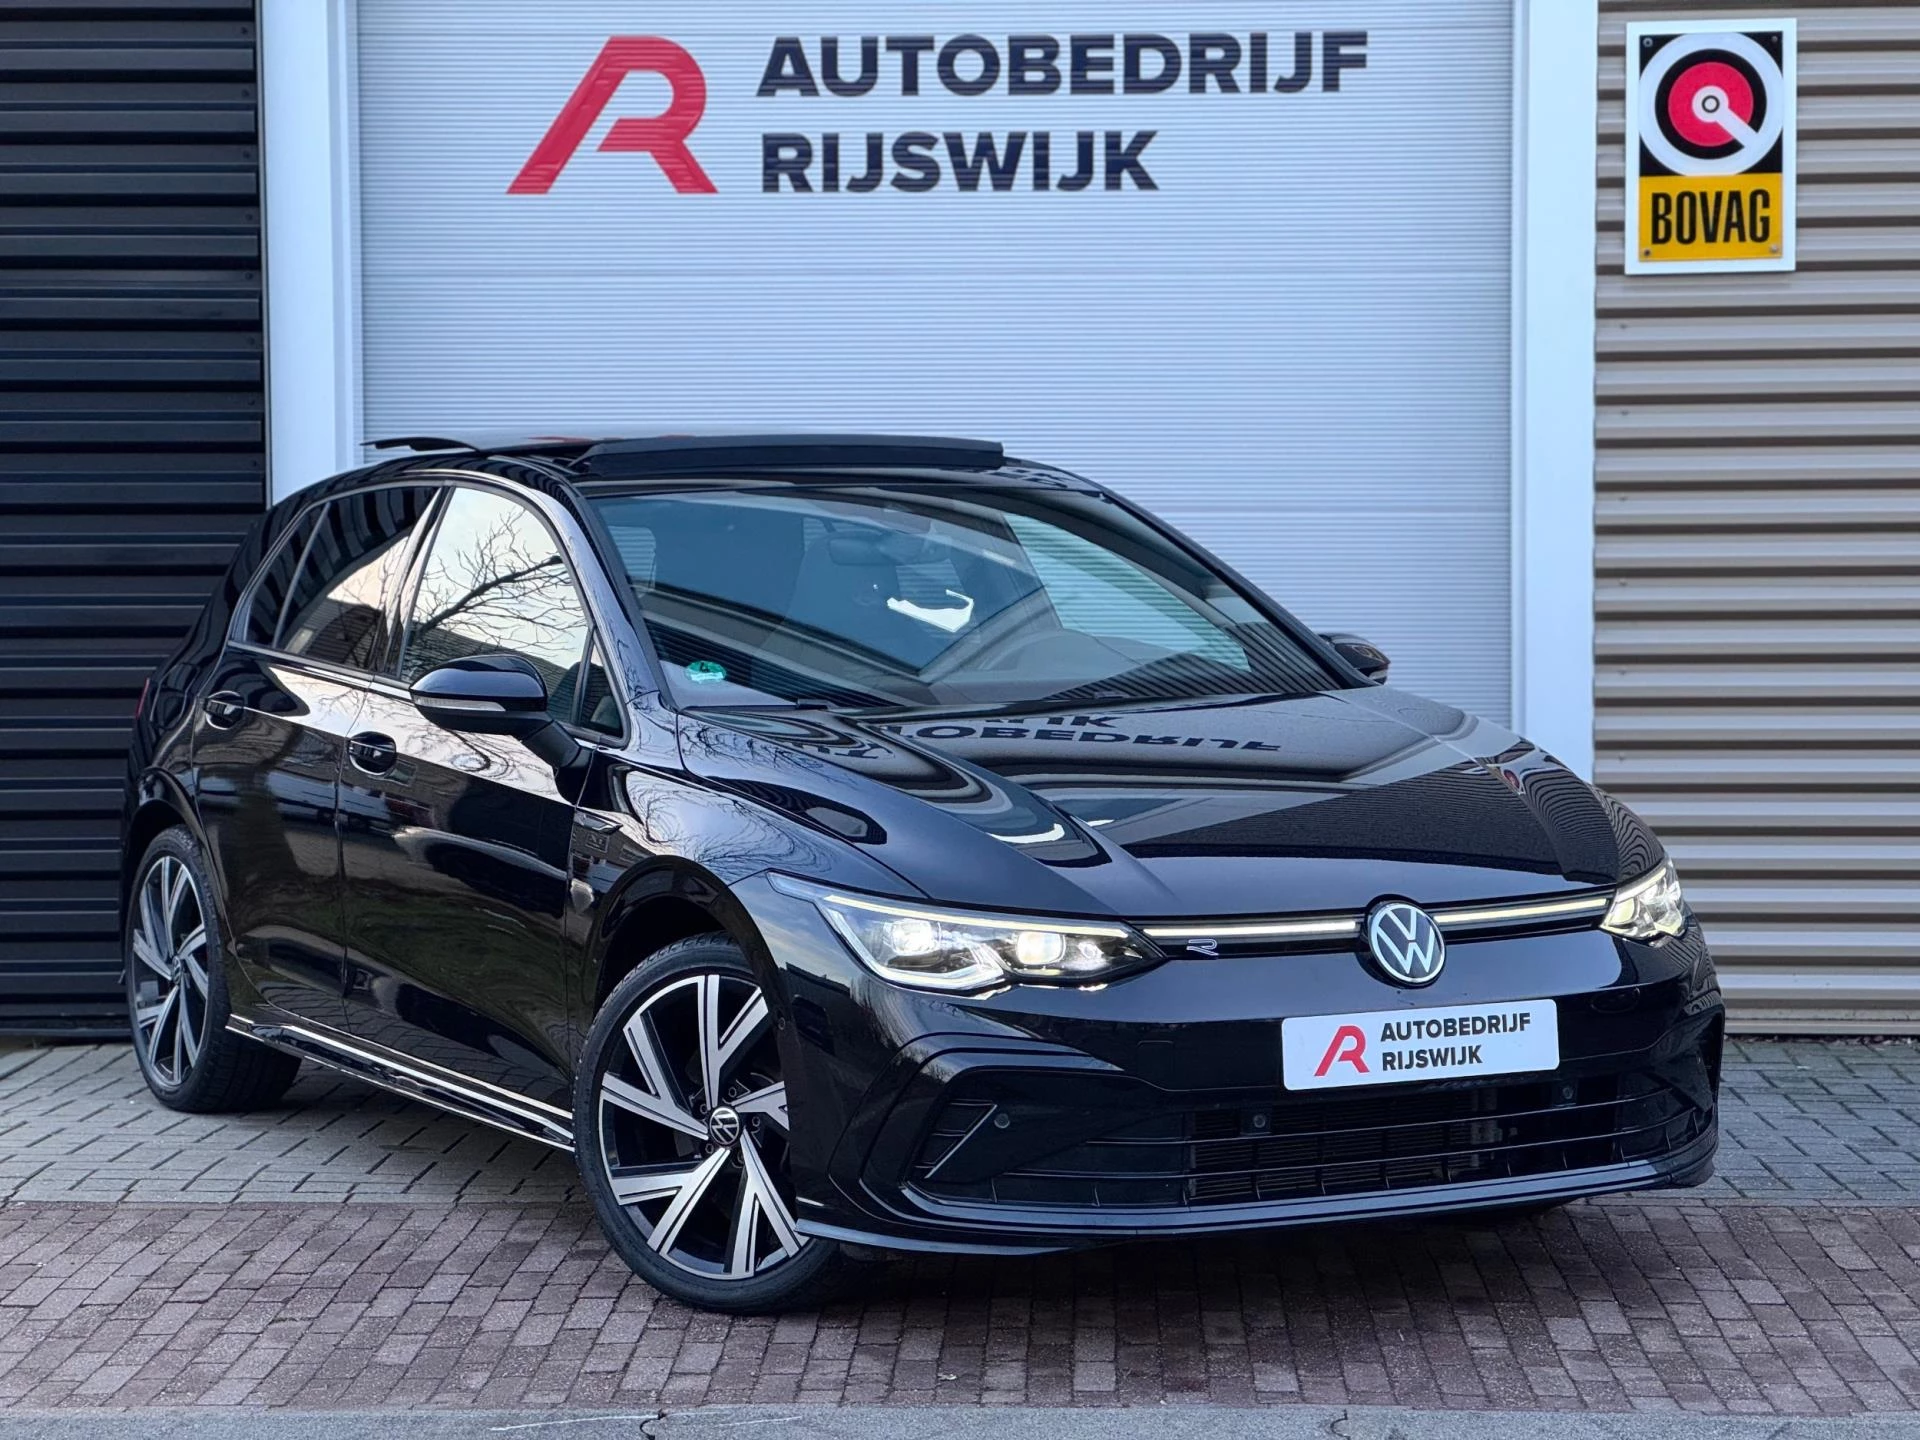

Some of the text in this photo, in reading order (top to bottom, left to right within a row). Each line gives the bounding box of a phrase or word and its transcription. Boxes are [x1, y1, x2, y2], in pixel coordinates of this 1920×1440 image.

[756, 31, 1368, 97] AUTOBEDRIJF
[762, 130, 1158, 193] RIJSWIJK
[1651, 188, 1770, 245] BOVAG
[1380, 1012, 1531, 1042] AUTOBEDRIJF
[1382, 1045, 1483, 1071] RIJSWIJK
